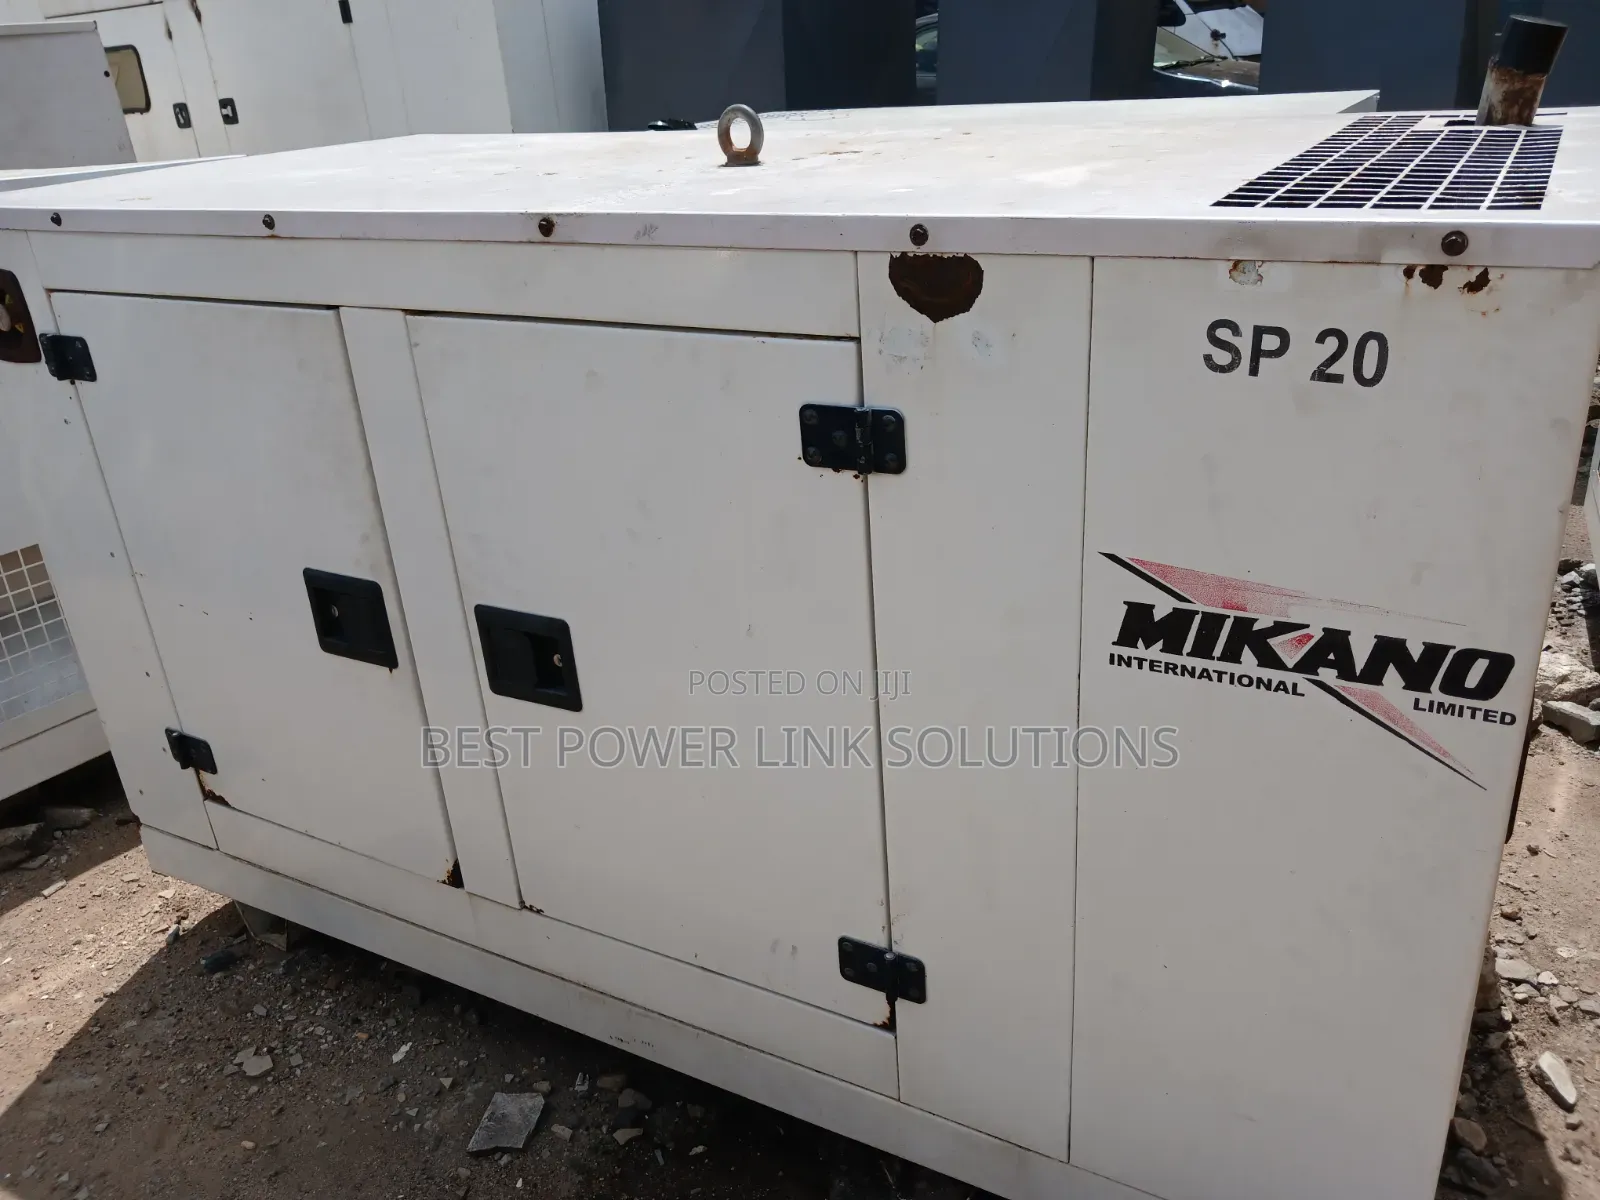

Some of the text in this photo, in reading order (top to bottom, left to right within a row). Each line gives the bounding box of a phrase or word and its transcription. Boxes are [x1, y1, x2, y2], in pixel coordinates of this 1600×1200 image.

[1202, 318, 1389, 388] SP 20
[1108, 652, 1305, 697] INTERNATIONAL
[1111, 600, 1516, 702] MIKANO
[1413, 697, 1517, 727] LIMITED
